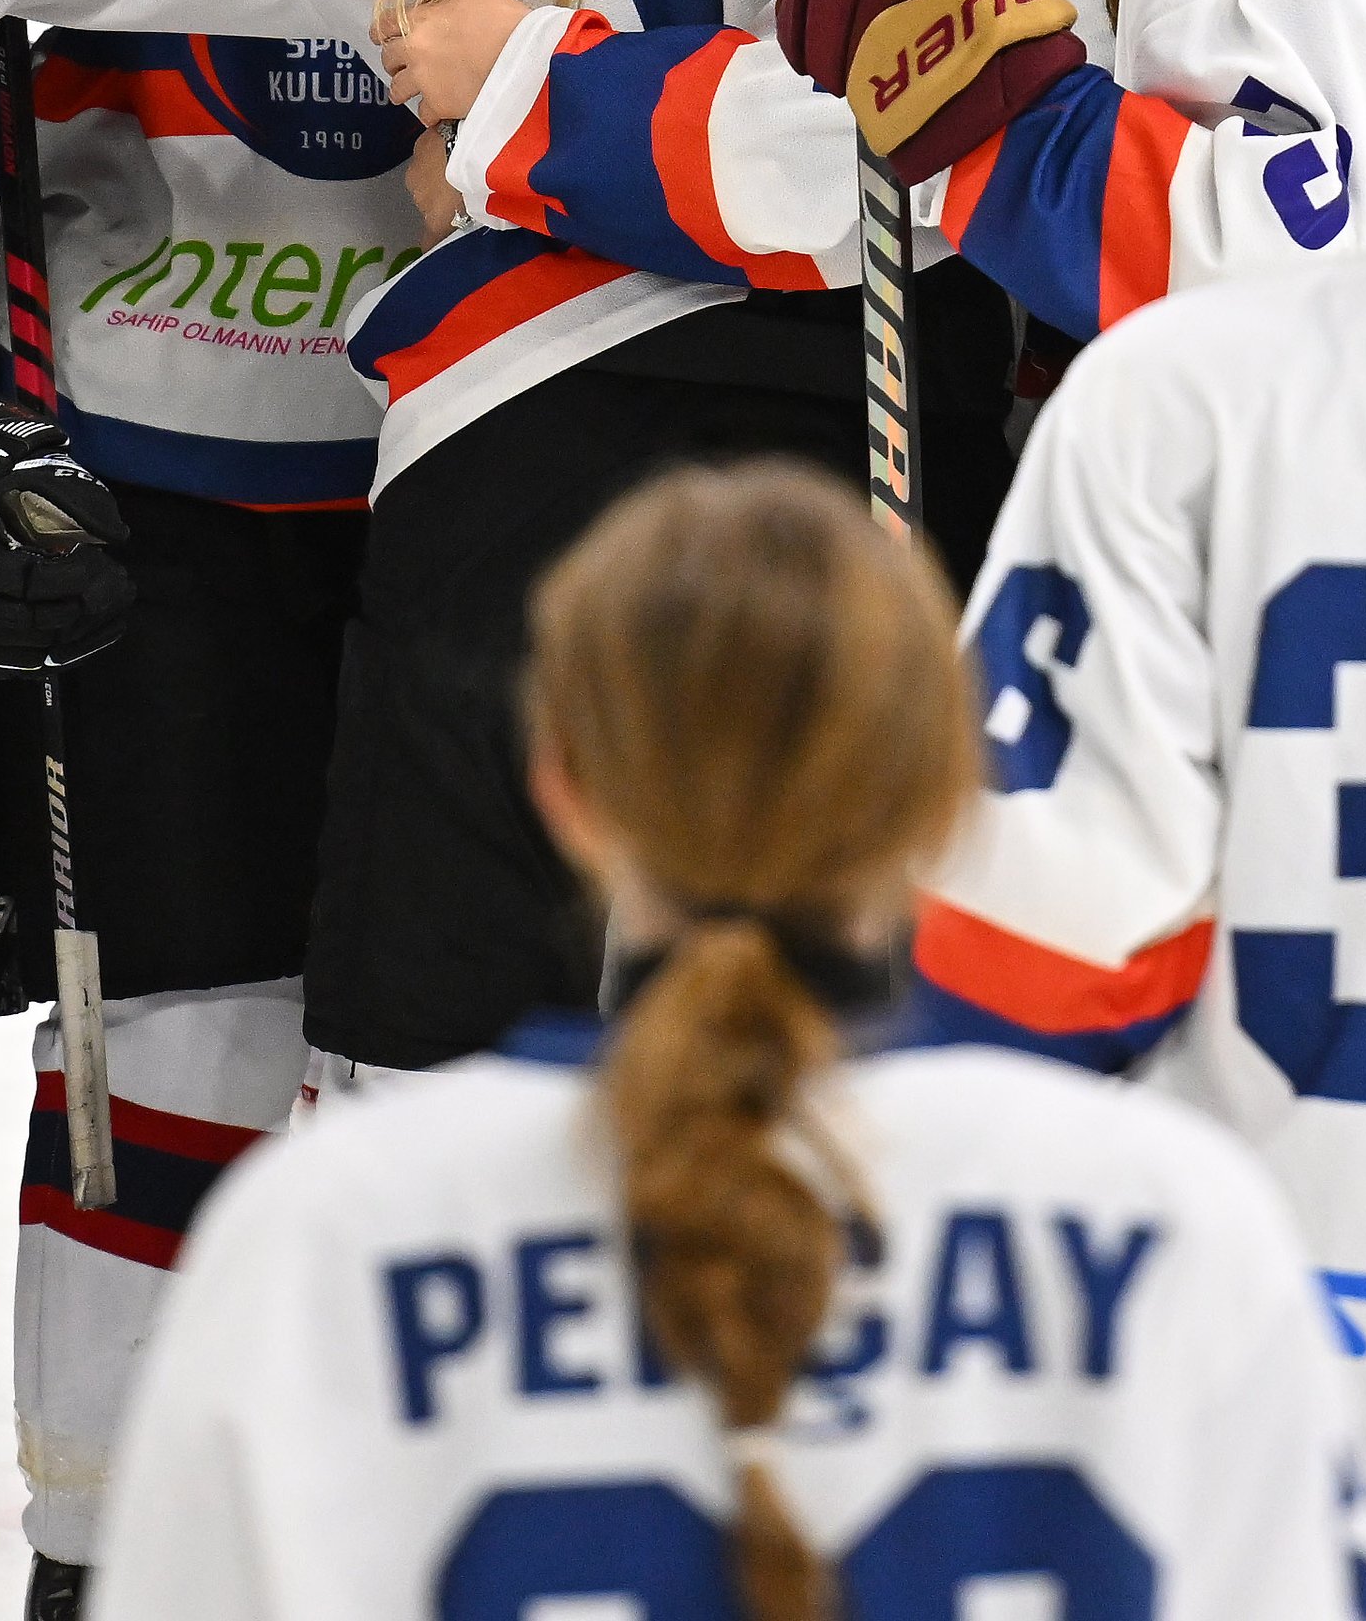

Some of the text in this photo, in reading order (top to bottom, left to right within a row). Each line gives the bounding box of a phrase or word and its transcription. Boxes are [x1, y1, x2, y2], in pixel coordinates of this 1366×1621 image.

[286, 37, 367, 60] SPO
[300, 129, 363, 150] 1990
[182, 321, 292, 356] OLMANIN
[299, 336, 347, 356] YEN
[45, 754, 76, 931] RRIOR
